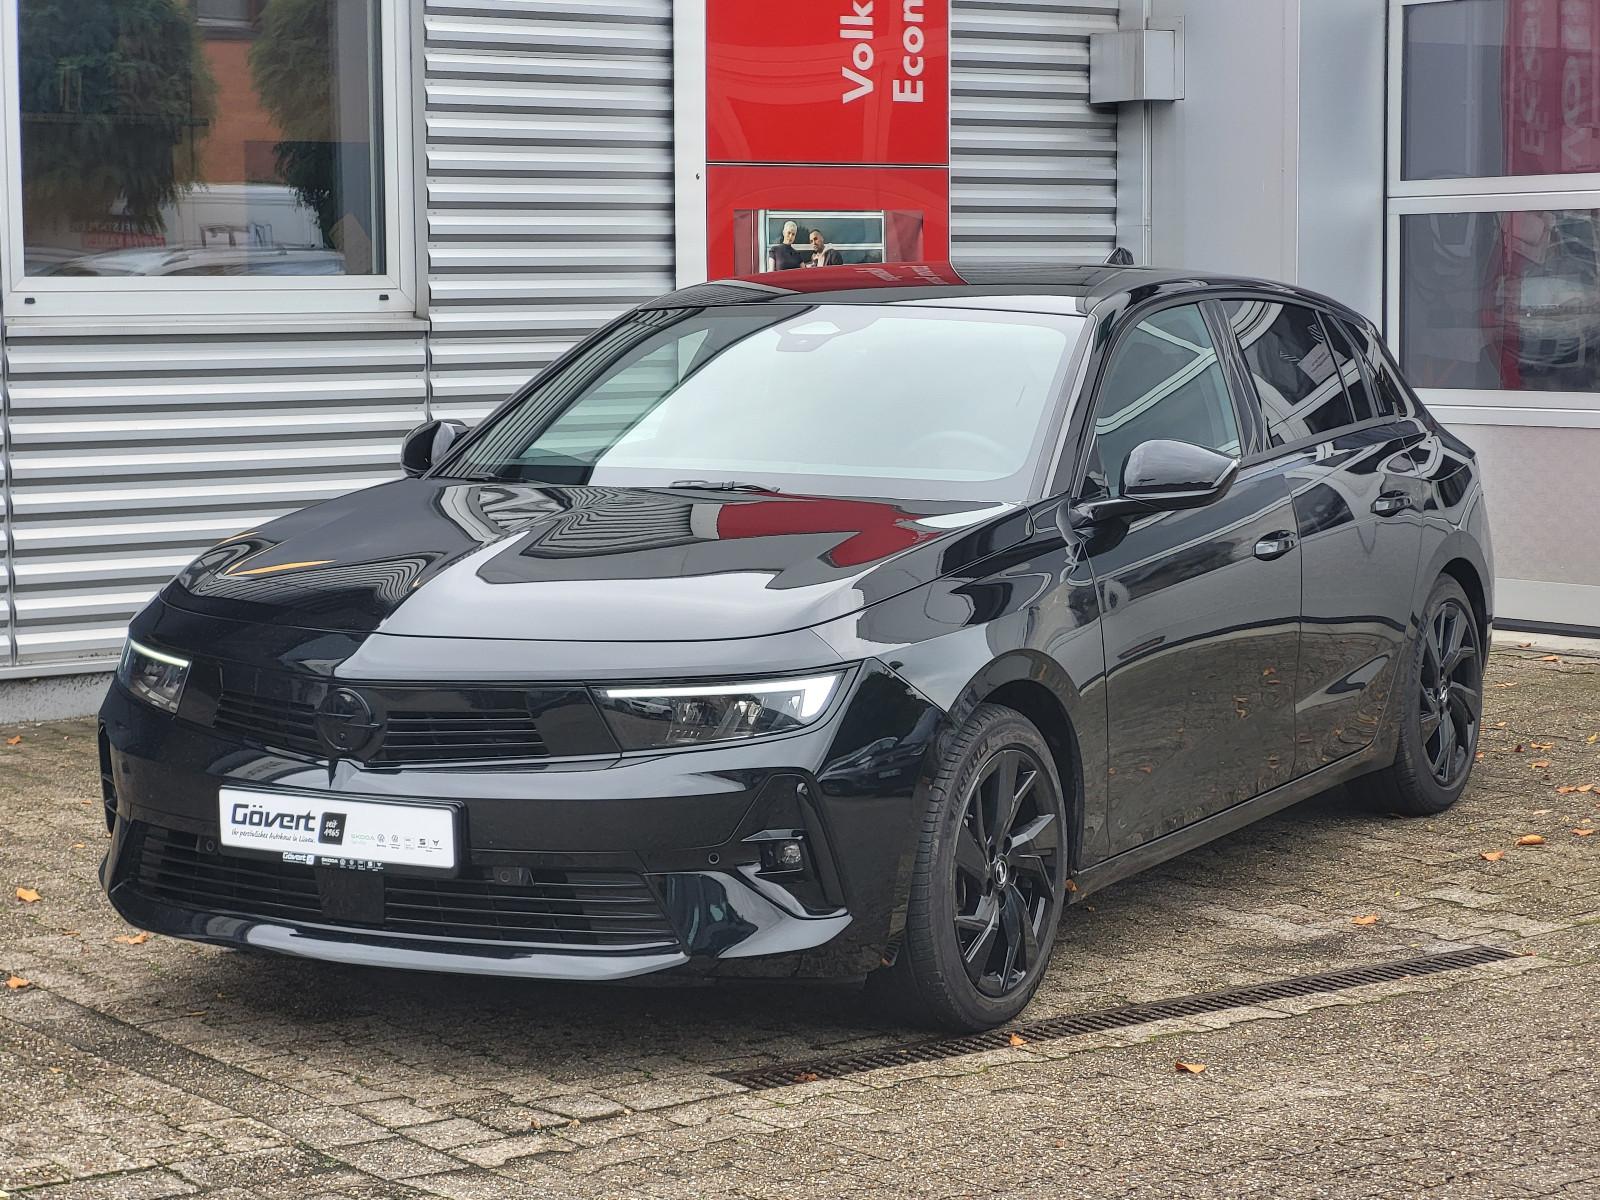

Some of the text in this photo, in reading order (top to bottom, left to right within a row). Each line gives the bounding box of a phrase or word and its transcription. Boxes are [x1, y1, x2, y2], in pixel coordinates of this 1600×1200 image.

[840, 0, 874, 105] Volk
[892, 0, 924, 103] Econ
[231, 803, 316, 832] Gövert
[325, 819, 339, 829] seit
[324, 828, 341, 838] 1965
